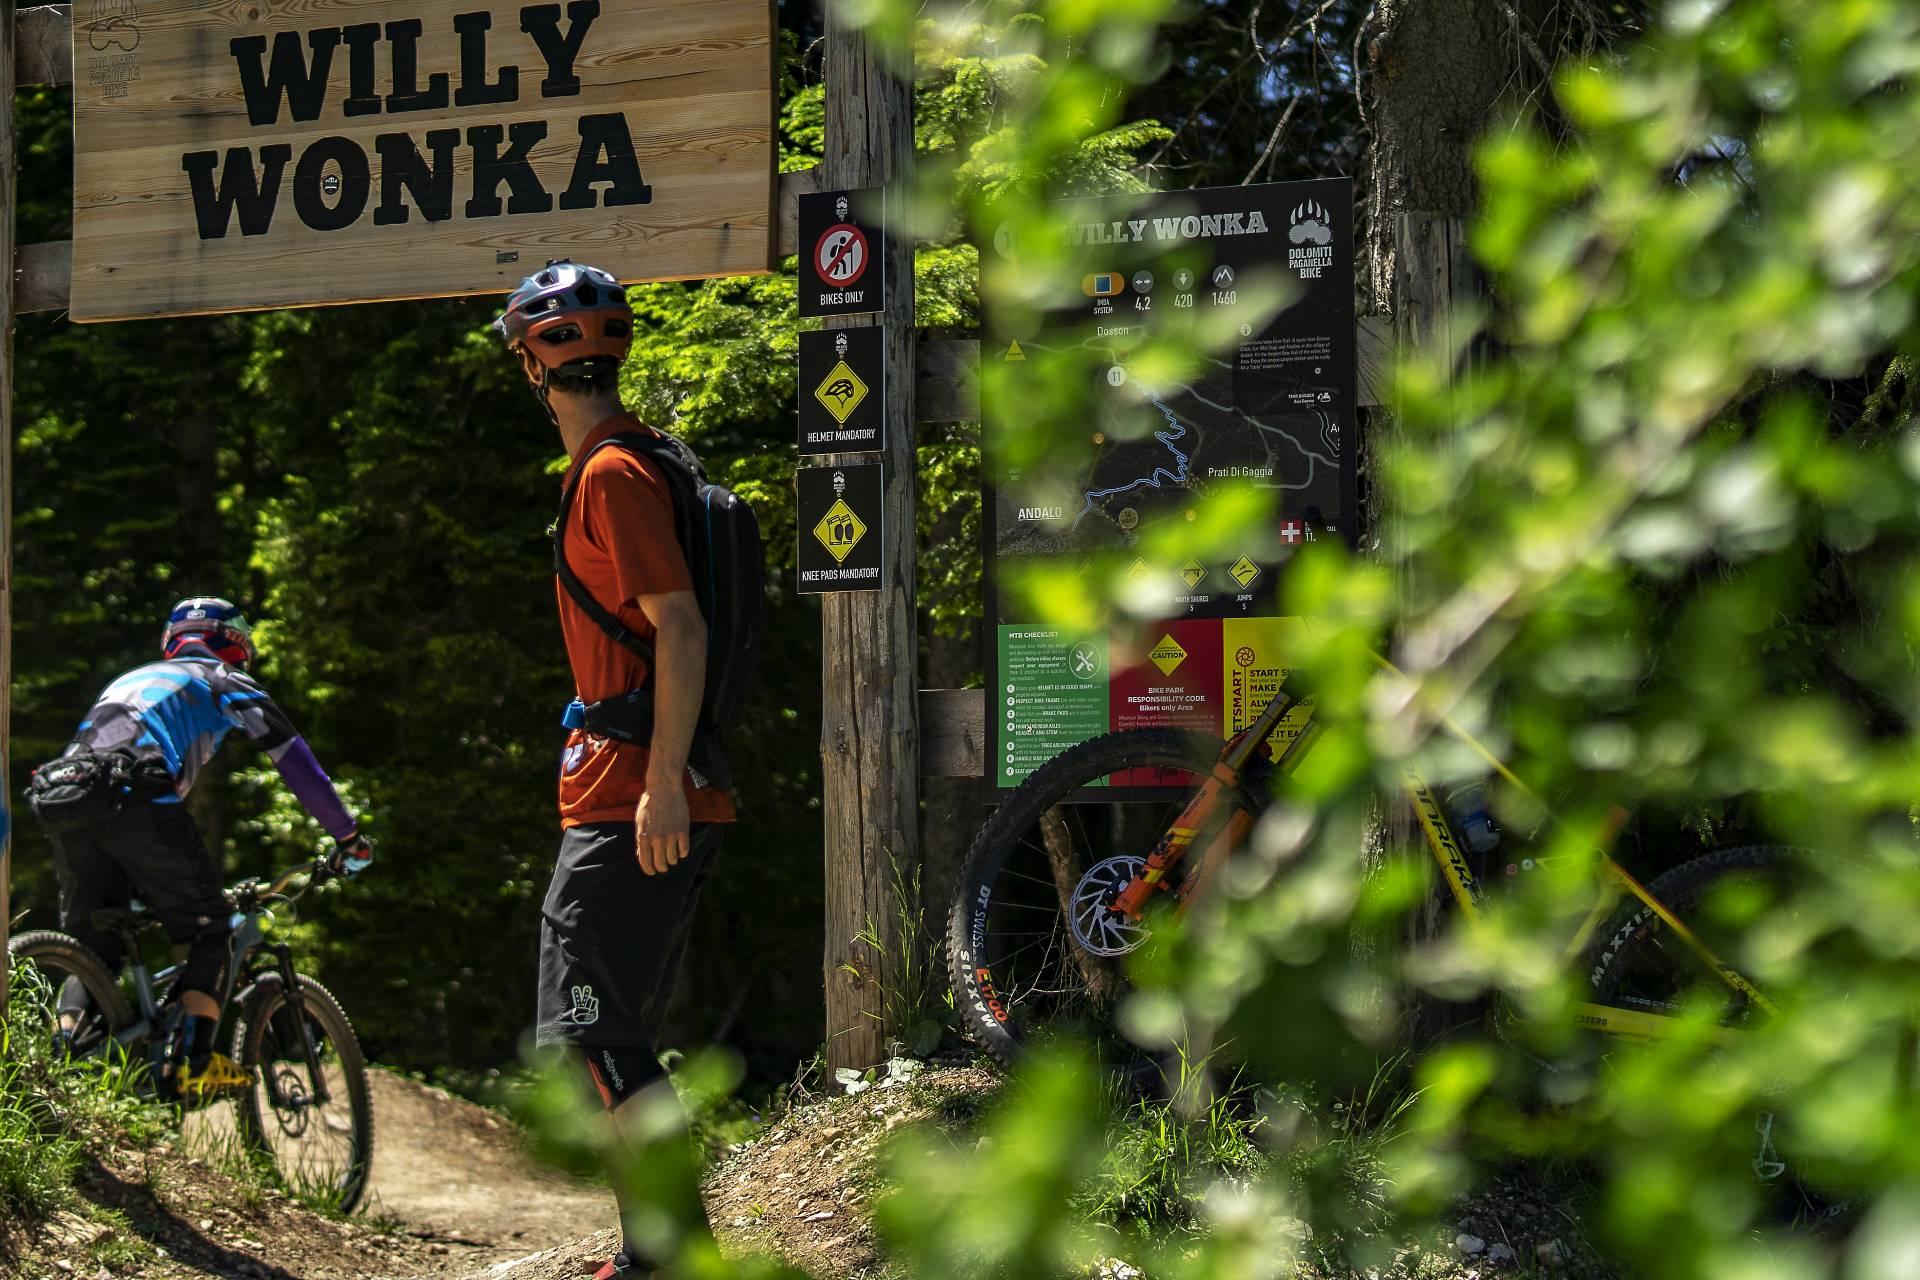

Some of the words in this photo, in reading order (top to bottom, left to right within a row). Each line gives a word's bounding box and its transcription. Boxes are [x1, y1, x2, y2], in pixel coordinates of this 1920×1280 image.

[230, 0, 600, 126] WILLY
[103, 82, 129, 99] BIKE
[182, 112, 652, 240] WONKA
[1062, 218, 1149, 247] WILLY
[1152, 210, 1269, 241] WONKA
[1288, 246, 1333, 260] DOLOMITI
[1288, 256, 1333, 269] PAGANELLA
[1299, 267, 1323, 280] BIKE
[820, 293, 844, 306] BIKES
[844, 290, 864, 304] ONLY
[1173, 292, 1194, 309] 420
[1211, 289, 1237, 307] 1460
[1093, 306, 1114, 315] SYSTEM
[1097, 326, 1130, 337] Dosson
[807, 431, 835, 443] HELMET
[835, 428, 876, 441] MANDATORY
[1208, 466, 1230, 478] Prati
[1231, 466, 1241, 477] Di
[1242, 465, 1274, 479] Gaggia
[1018, 506, 1063, 520] ANDALO
[1305, 532, 1317, 542] 11
[802, 570, 820, 581] KNEE
[820, 569, 838, 581] PADS
[839, 567, 879, 580] MANDATORY
[1237, 594, 1253, 602] JUMPS
[1249, 669, 1279, 677] START
[1165, 686, 1185, 694] PARK
[1249, 684, 1277, 692] MAKE
[1127, 695, 1184, 703] RESPONSIBILITY
[1232, 669, 1243, 732] ETSMART
[1249, 699, 1270, 708] ALW
[1161, 704, 1176, 712] only
[1276, 730, 1285, 738] IT
[1287, 730, 1300, 738] EA
[976, 884, 993, 910] DT
[972, 910, 987, 949] SWISS
[1591, 906, 1654, 988] MAXXIS
[960, 950, 998, 1029] MAXXIS
